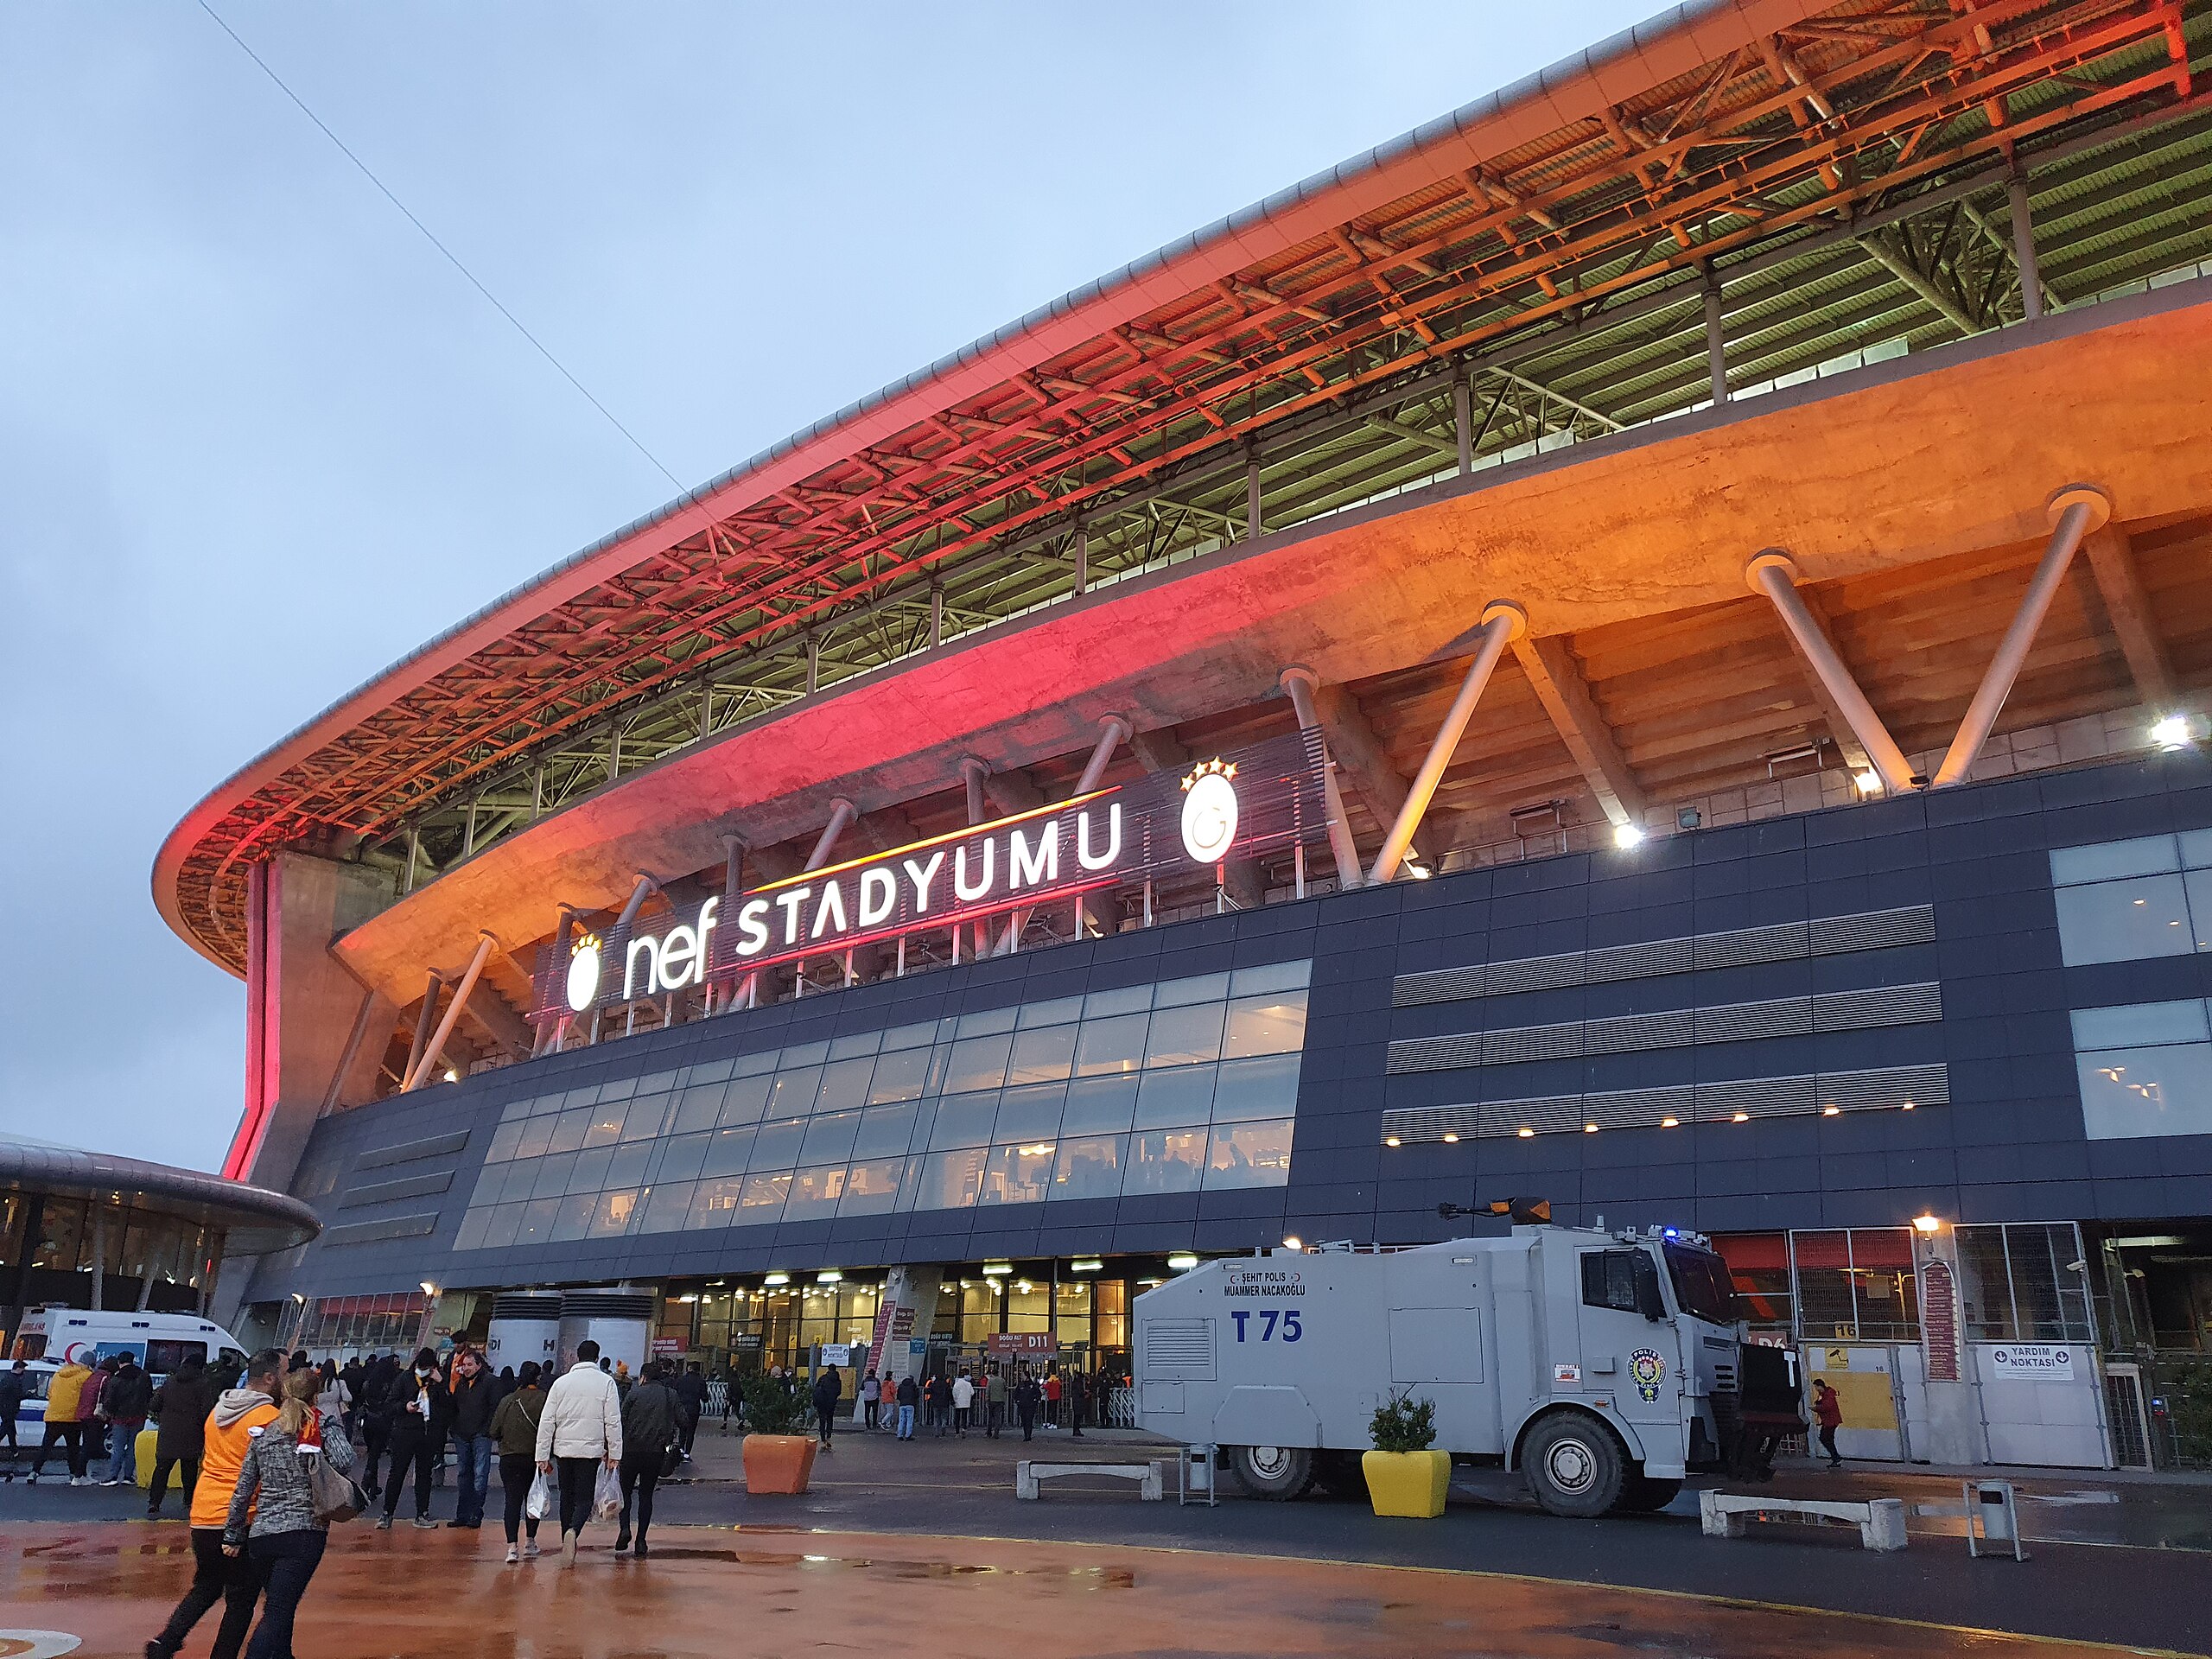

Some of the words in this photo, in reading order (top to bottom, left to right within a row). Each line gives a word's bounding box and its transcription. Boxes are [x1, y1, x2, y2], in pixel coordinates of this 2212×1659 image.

[622, 895, 719, 1001] nef
[735, 802, 1122, 956] STADYUMU
[1224, 1285, 1260, 1296] MUAMMER
[1262, 1282, 1306, 1296] NACAKOĞLU
[1231, 1311, 1250, 1343] T
[1259, 1310, 1303, 1343] 75
[1028, 1335, 1048, 1348] D11
[2012, 1347, 2050, 1356] YARDIM
[2011, 1358, 2056, 1367] NOKTASI
